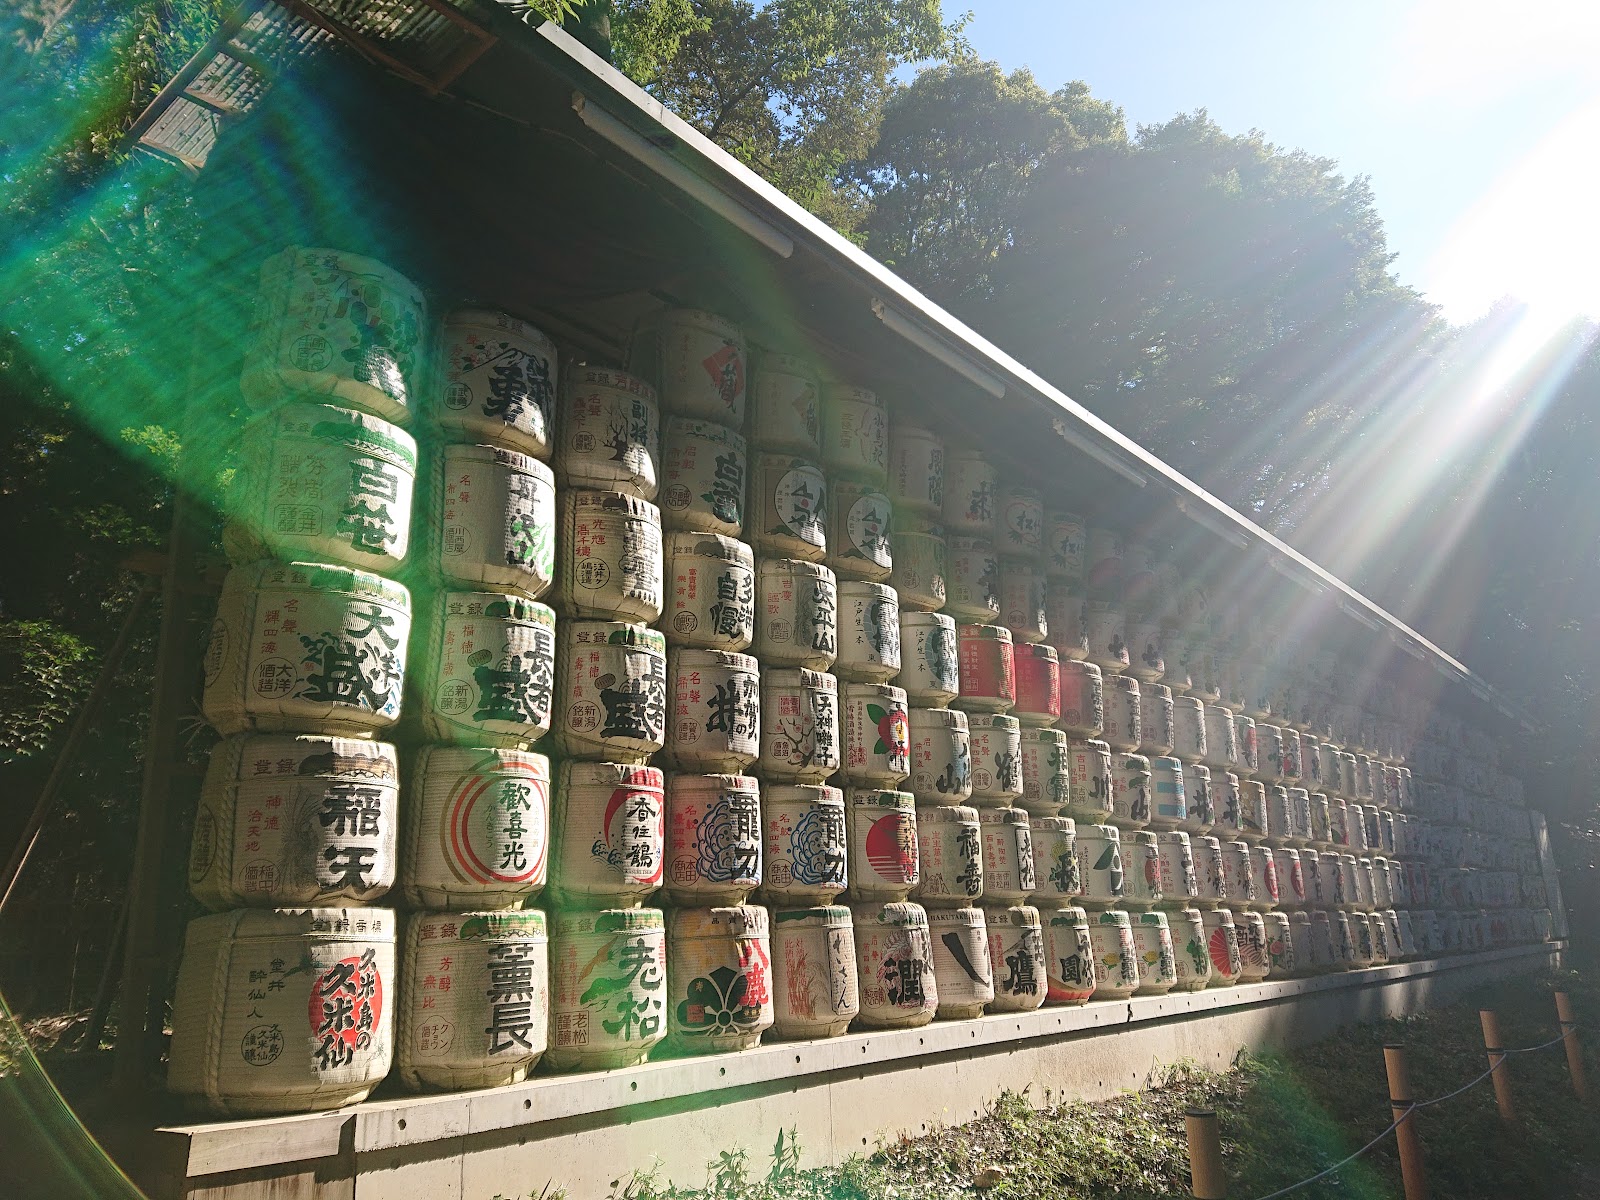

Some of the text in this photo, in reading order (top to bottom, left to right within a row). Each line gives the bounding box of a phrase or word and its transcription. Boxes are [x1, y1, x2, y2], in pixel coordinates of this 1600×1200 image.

[448, 602, 484, 616] 登録
[577, 631, 608, 644] 登録
[254, 758, 299, 775] 登録
[499, 781, 531, 871] 歓喜光
[626, 797, 656, 868] 香住鶴
[420, 923, 458, 941] 登録
[422, 975, 437, 1009] 無比
[438, 956, 453, 992] 芳醇
[601, 937, 663, 1042] 老松
[314, 962, 357, 1071] 久米仙
[355, 946, 378, 1052] 久米島の
